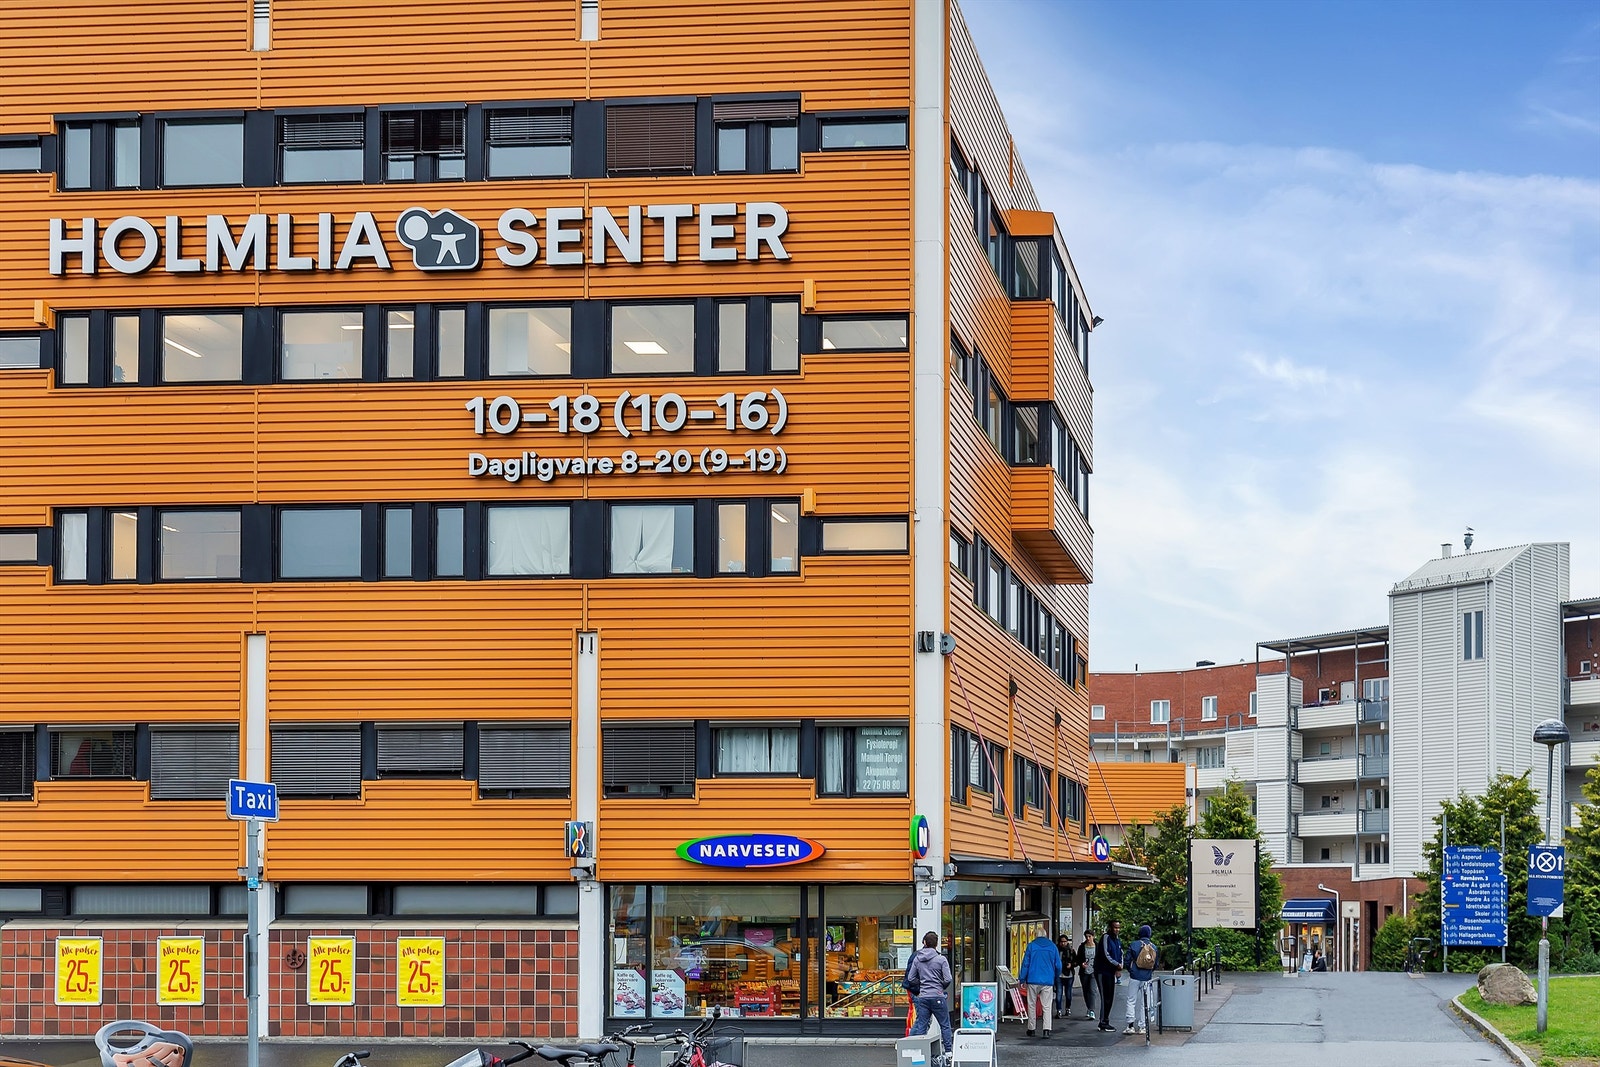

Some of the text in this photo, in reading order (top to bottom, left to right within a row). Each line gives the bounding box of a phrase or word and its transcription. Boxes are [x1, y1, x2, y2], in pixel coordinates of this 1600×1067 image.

[49, 202, 792, 276] HOLMLIA SENTER
[468, 452, 614, 482] Dagligvare
[866, 739, 898, 750] Fysioterapi
[861, 752, 903, 764] Manuell Terapi
[866, 766, 898, 777] Akupunktur
[863, 780, 871, 790] 22
[873, 780, 881, 790] 75
[882, 780, 891, 790] 09
[235, 786, 272, 810] Taxi
[918, 826, 928, 848] N
[700, 844, 800, 857] NARVESEN
[1096, 842, 1106, 856] N
[61, 946, 99, 957] Alle pølser
[162, 946, 200, 957] Alle pølser
[313, 945, 351, 957] Alle pølser
[402, 946, 440, 957] Alle pølser
[66, 960, 97, 994] 25,-
[168, 960, 198, 994] 25,-
[320, 960, 350, 994] 25,-
[408, 960, 438, 995] 25,-
